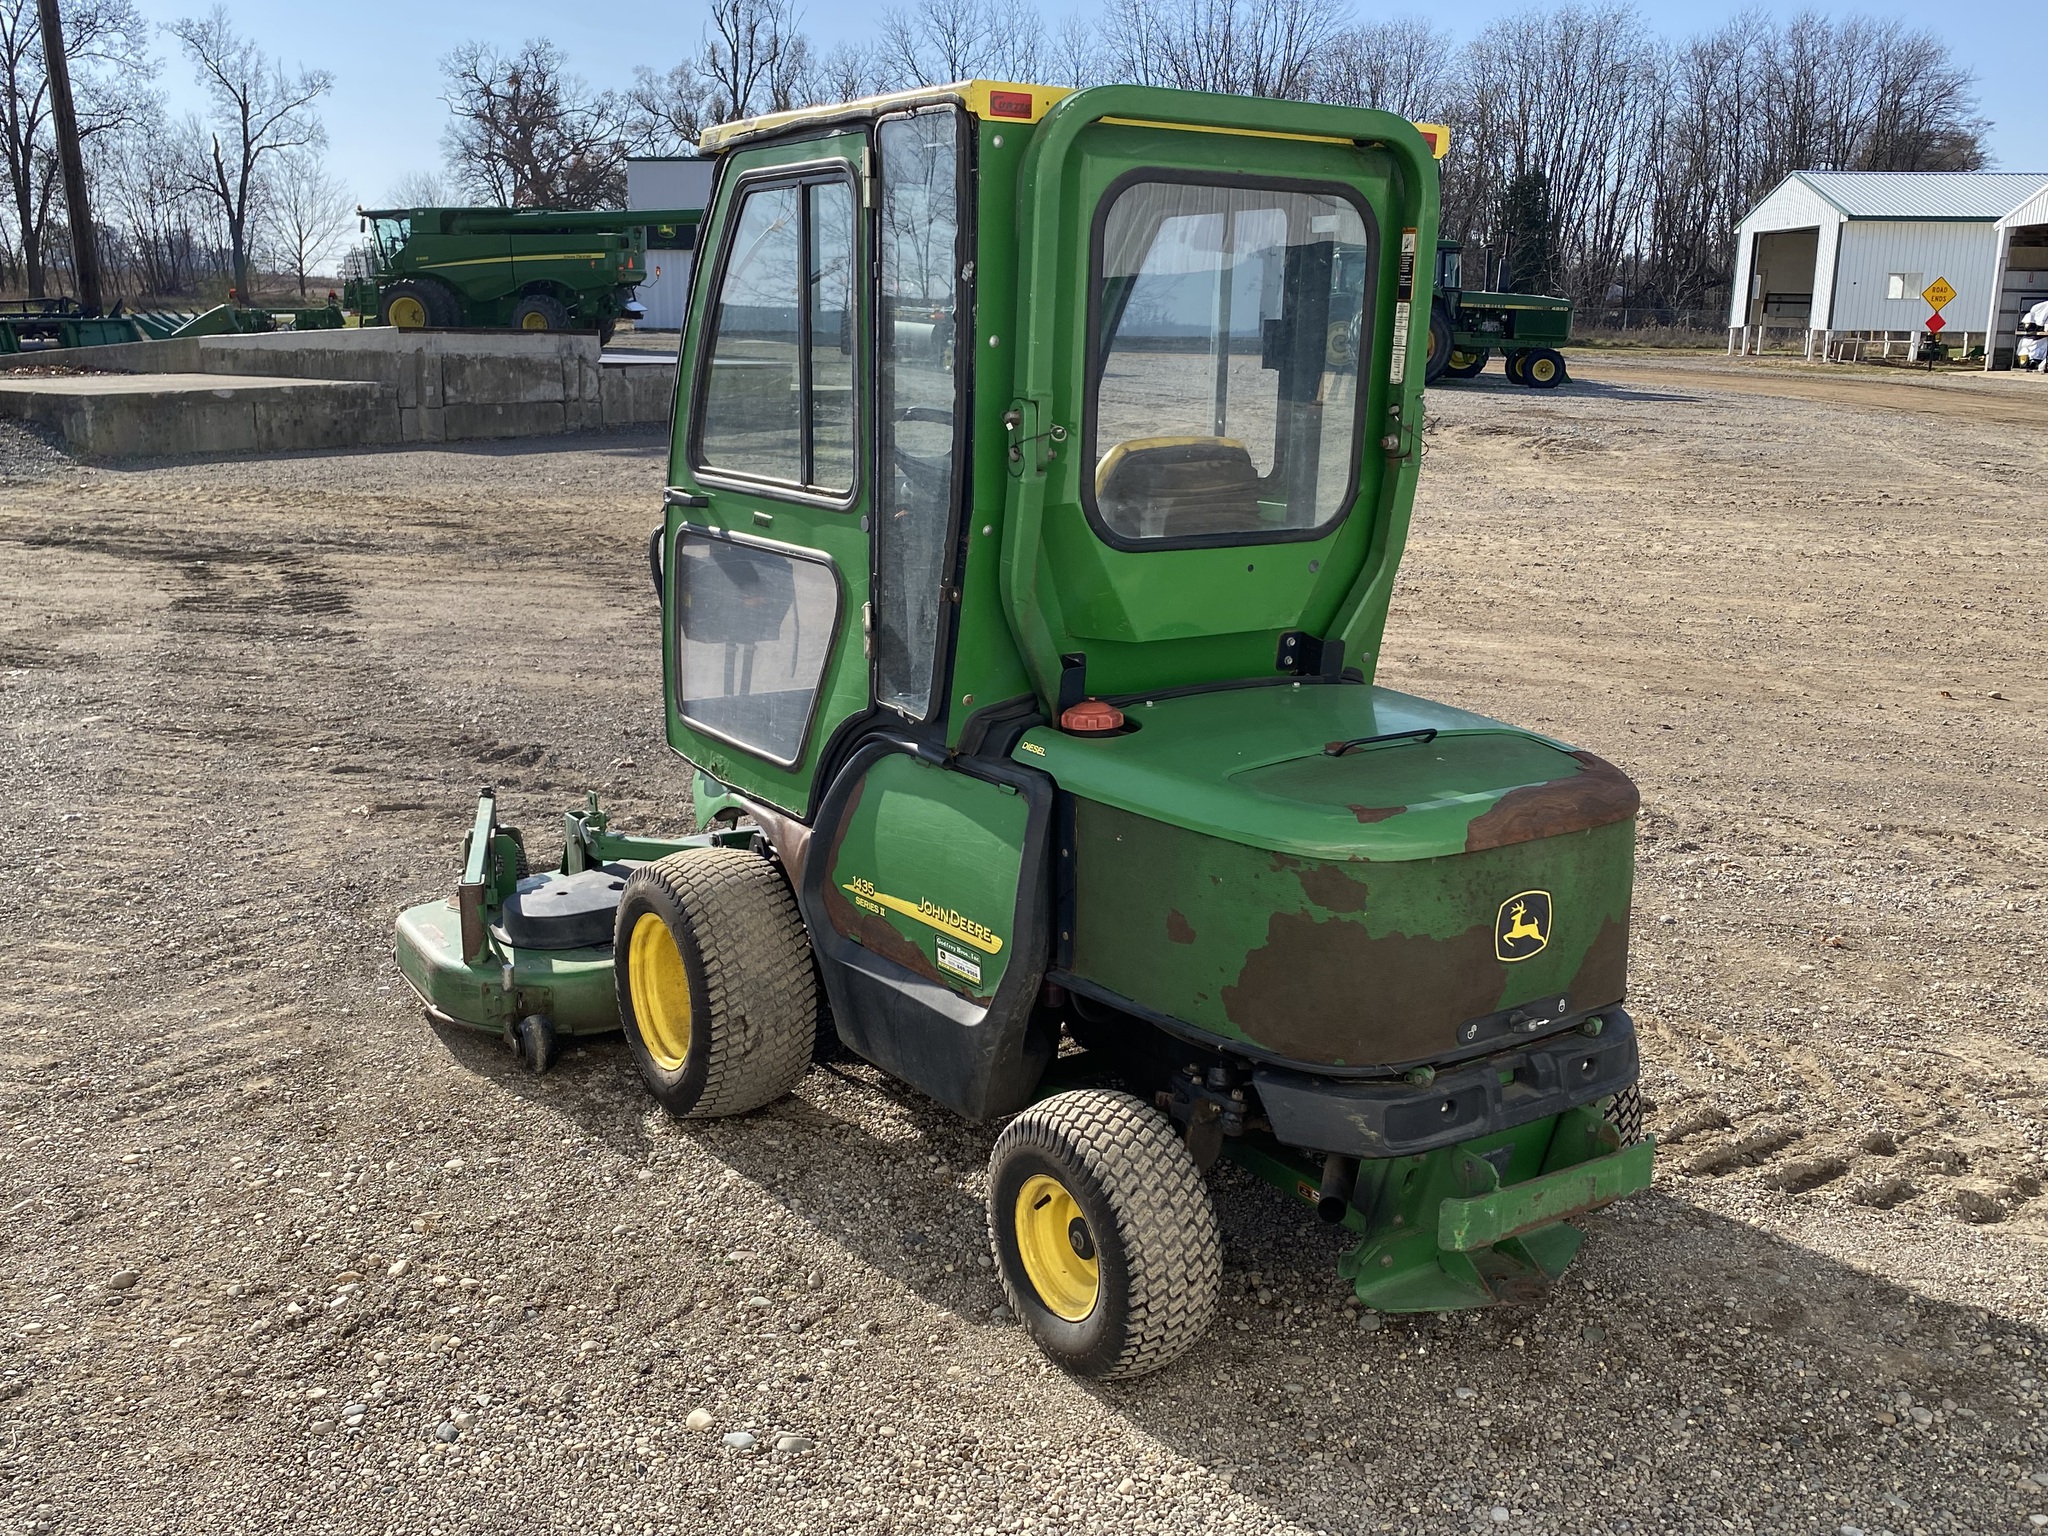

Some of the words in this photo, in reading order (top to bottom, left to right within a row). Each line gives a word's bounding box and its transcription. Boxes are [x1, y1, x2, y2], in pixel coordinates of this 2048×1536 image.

[1021, 741, 1046, 757] DIESEL
[852, 876, 874, 896] 1435
[855, 896, 879, 914] SERIES
